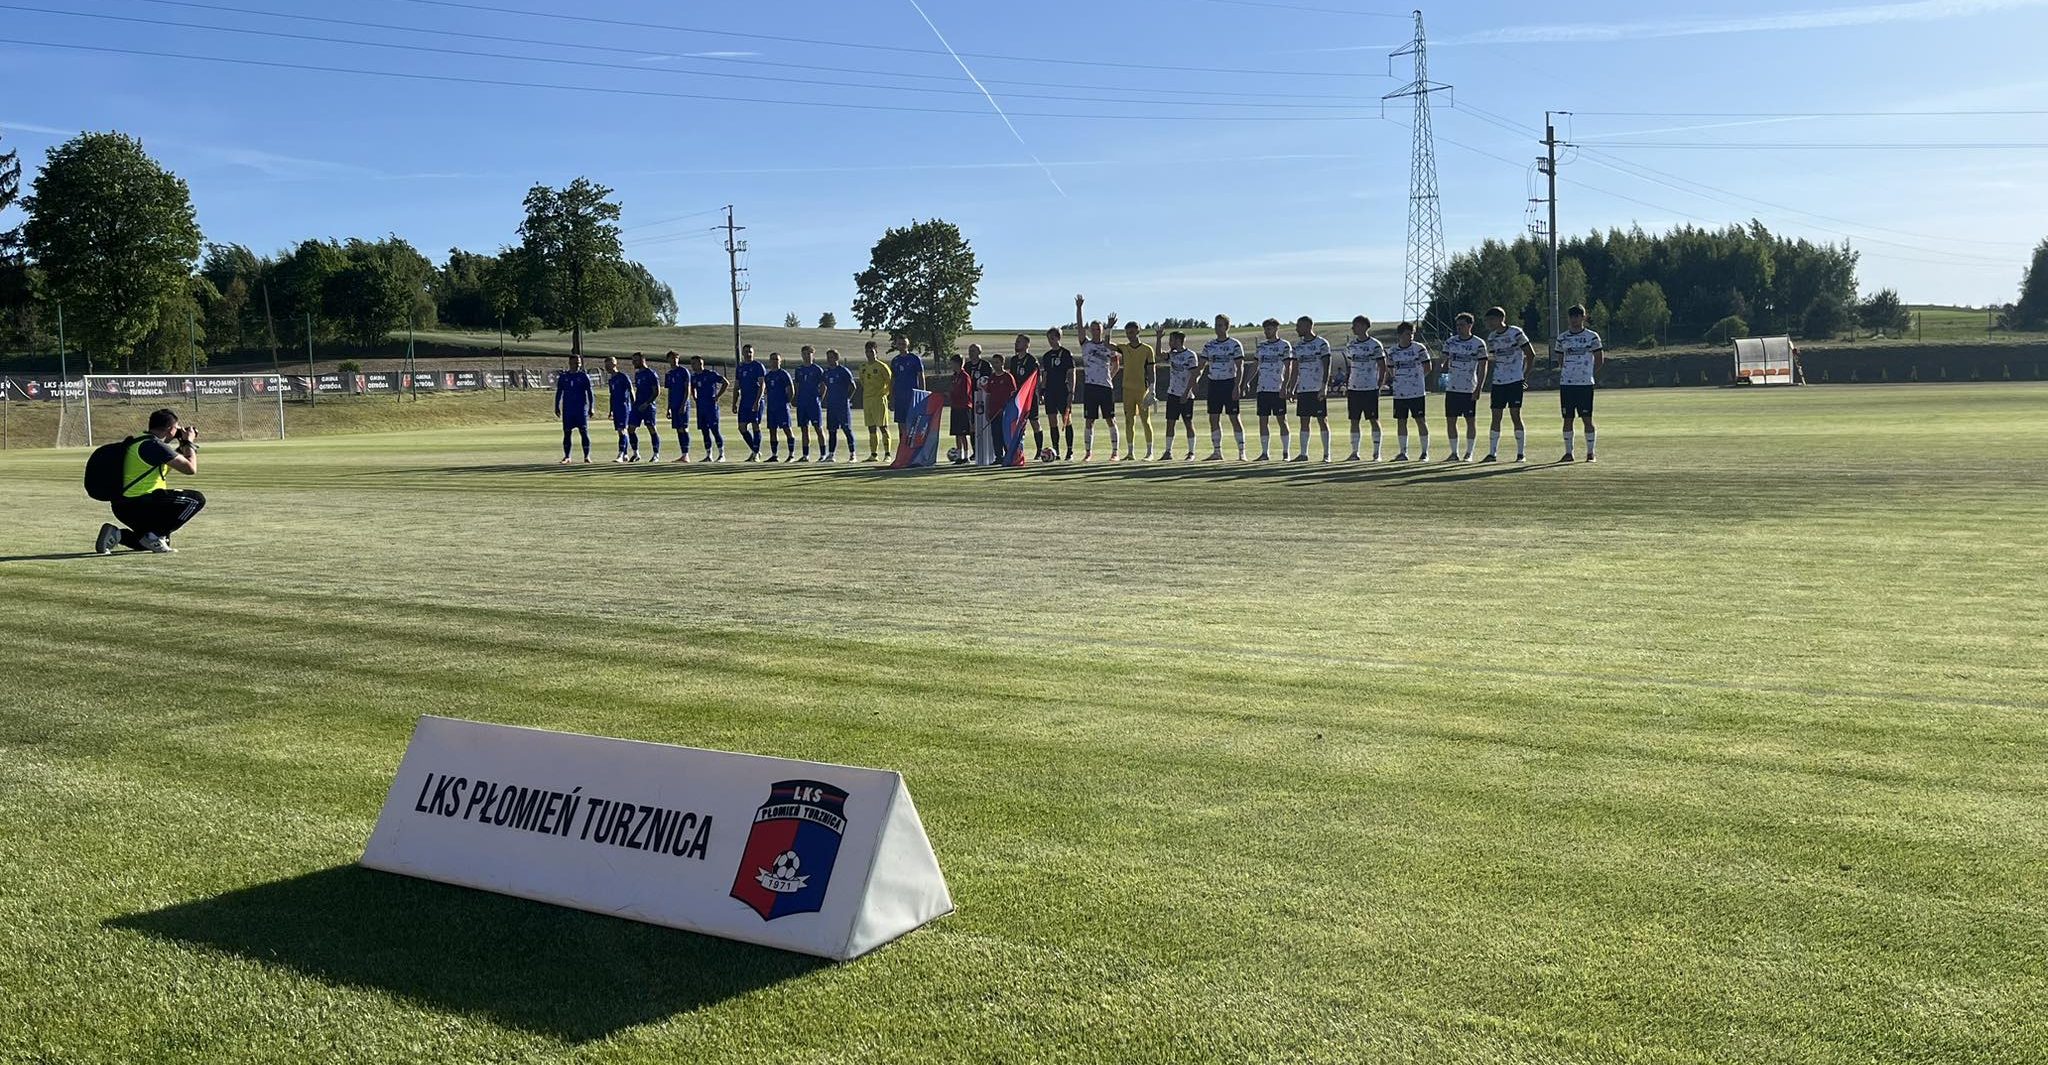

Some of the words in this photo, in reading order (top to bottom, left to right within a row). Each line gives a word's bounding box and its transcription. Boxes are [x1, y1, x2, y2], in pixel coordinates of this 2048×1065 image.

[43, 381, 57, 389] LKS
[793, 786, 823, 803] LKS
[415, 773, 467, 817] LKS
[463, 786, 582, 837] PŁOMIEŃ
[580, 797, 713, 860] TURZNICA
[761, 805, 800, 819] PŁOMIEŃ
[803, 807, 842, 831] TURZNICA
[768, 879, 791, 890] 1971
